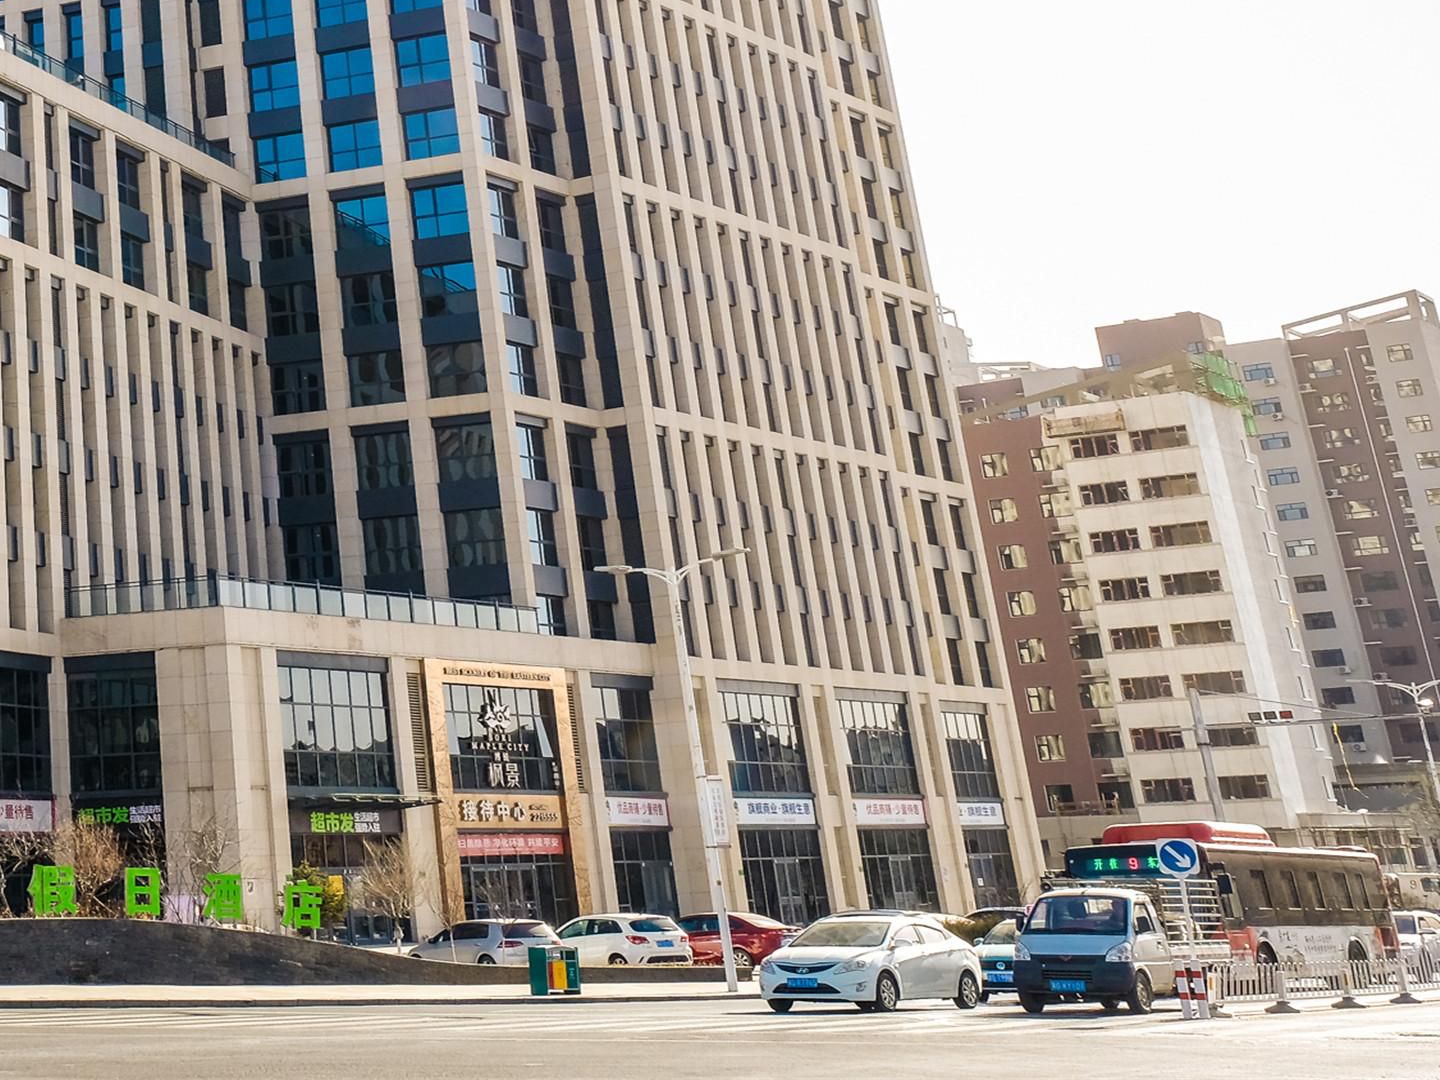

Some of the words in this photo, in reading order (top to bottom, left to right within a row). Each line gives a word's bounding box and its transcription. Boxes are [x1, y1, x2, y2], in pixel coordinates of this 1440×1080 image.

[471, 741, 504, 751] MAPLE
[506, 742, 530, 752] CITY
[77, 806, 129, 825] 超市发
[460, 799, 527, 822] 接待中心
[310, 811, 355, 833] 超市发
[1128, 856, 1139, 870] 9
